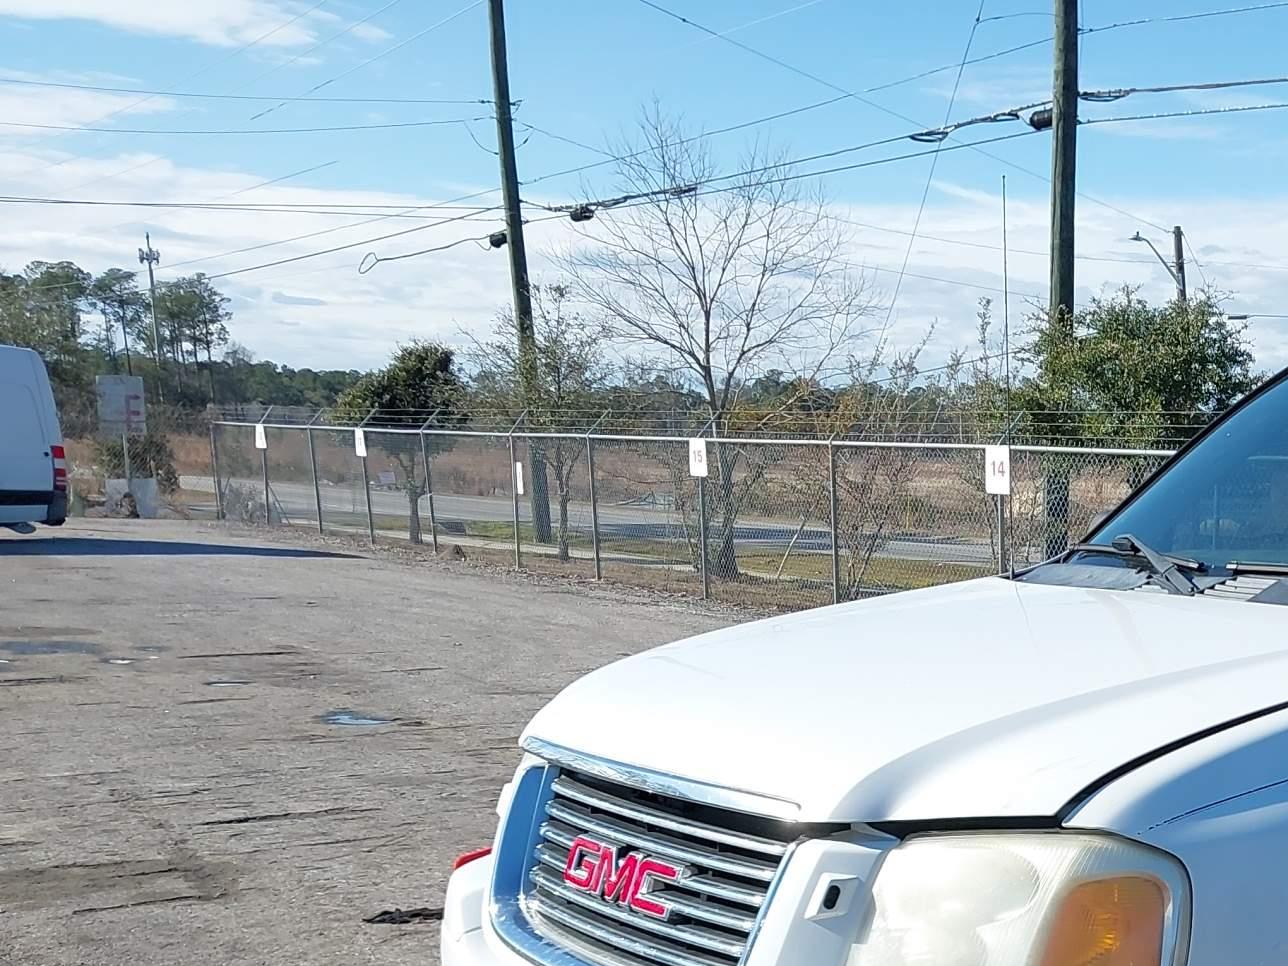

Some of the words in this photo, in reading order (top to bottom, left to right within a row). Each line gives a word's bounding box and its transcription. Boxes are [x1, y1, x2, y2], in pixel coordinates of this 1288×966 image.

[693, 449, 703, 464] 15
[991, 460, 1006, 477] 14
[563, 834, 684, 921] GMC
